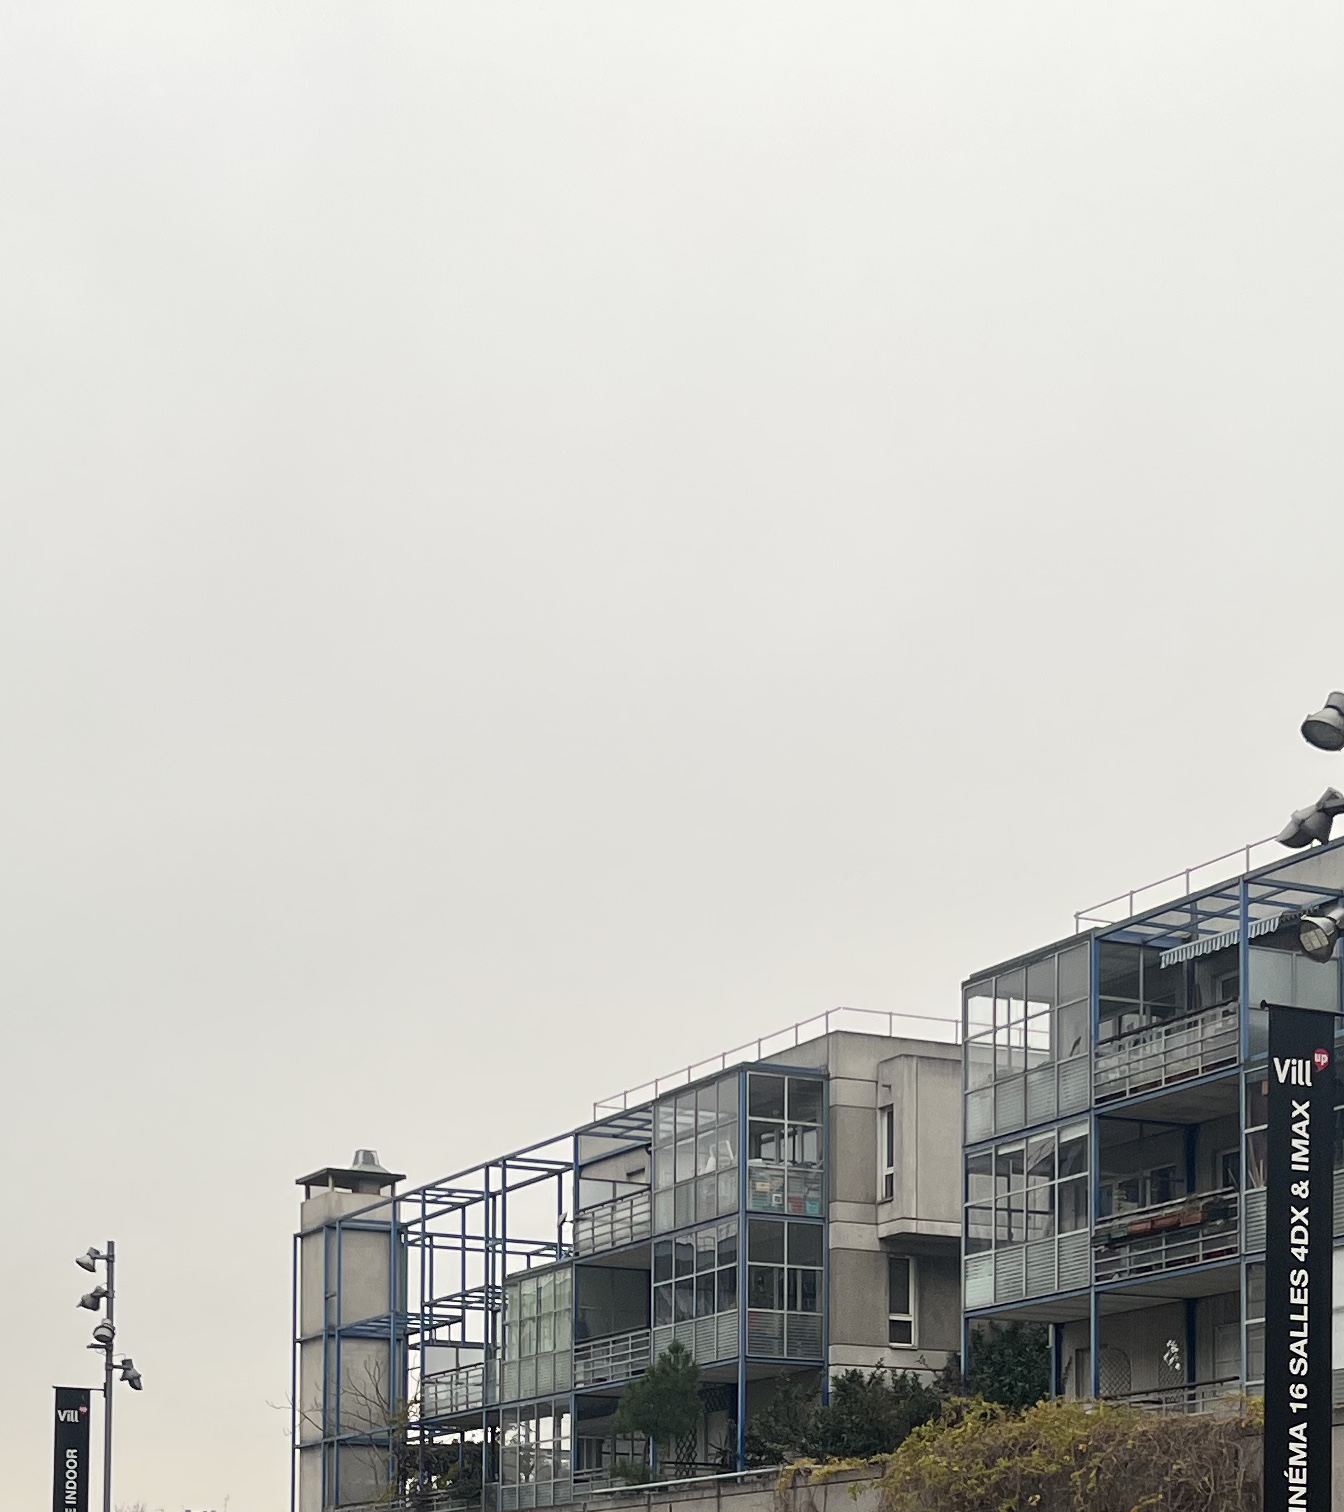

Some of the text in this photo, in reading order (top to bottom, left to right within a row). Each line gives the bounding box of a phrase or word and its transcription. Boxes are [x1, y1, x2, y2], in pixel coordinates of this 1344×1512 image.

[1273, 1057, 1313, 1087] Vill
[1291, 1099, 1310, 1172] IMAX
[1290, 1179, 1310, 1199] &
[1290, 1205, 1309, 1262] 4DX
[1289, 1268, 1309, 1376] SALLES
[1289, 1383, 1308, 1414] 16
[65, 1448, 78, 1505] INDOOR
